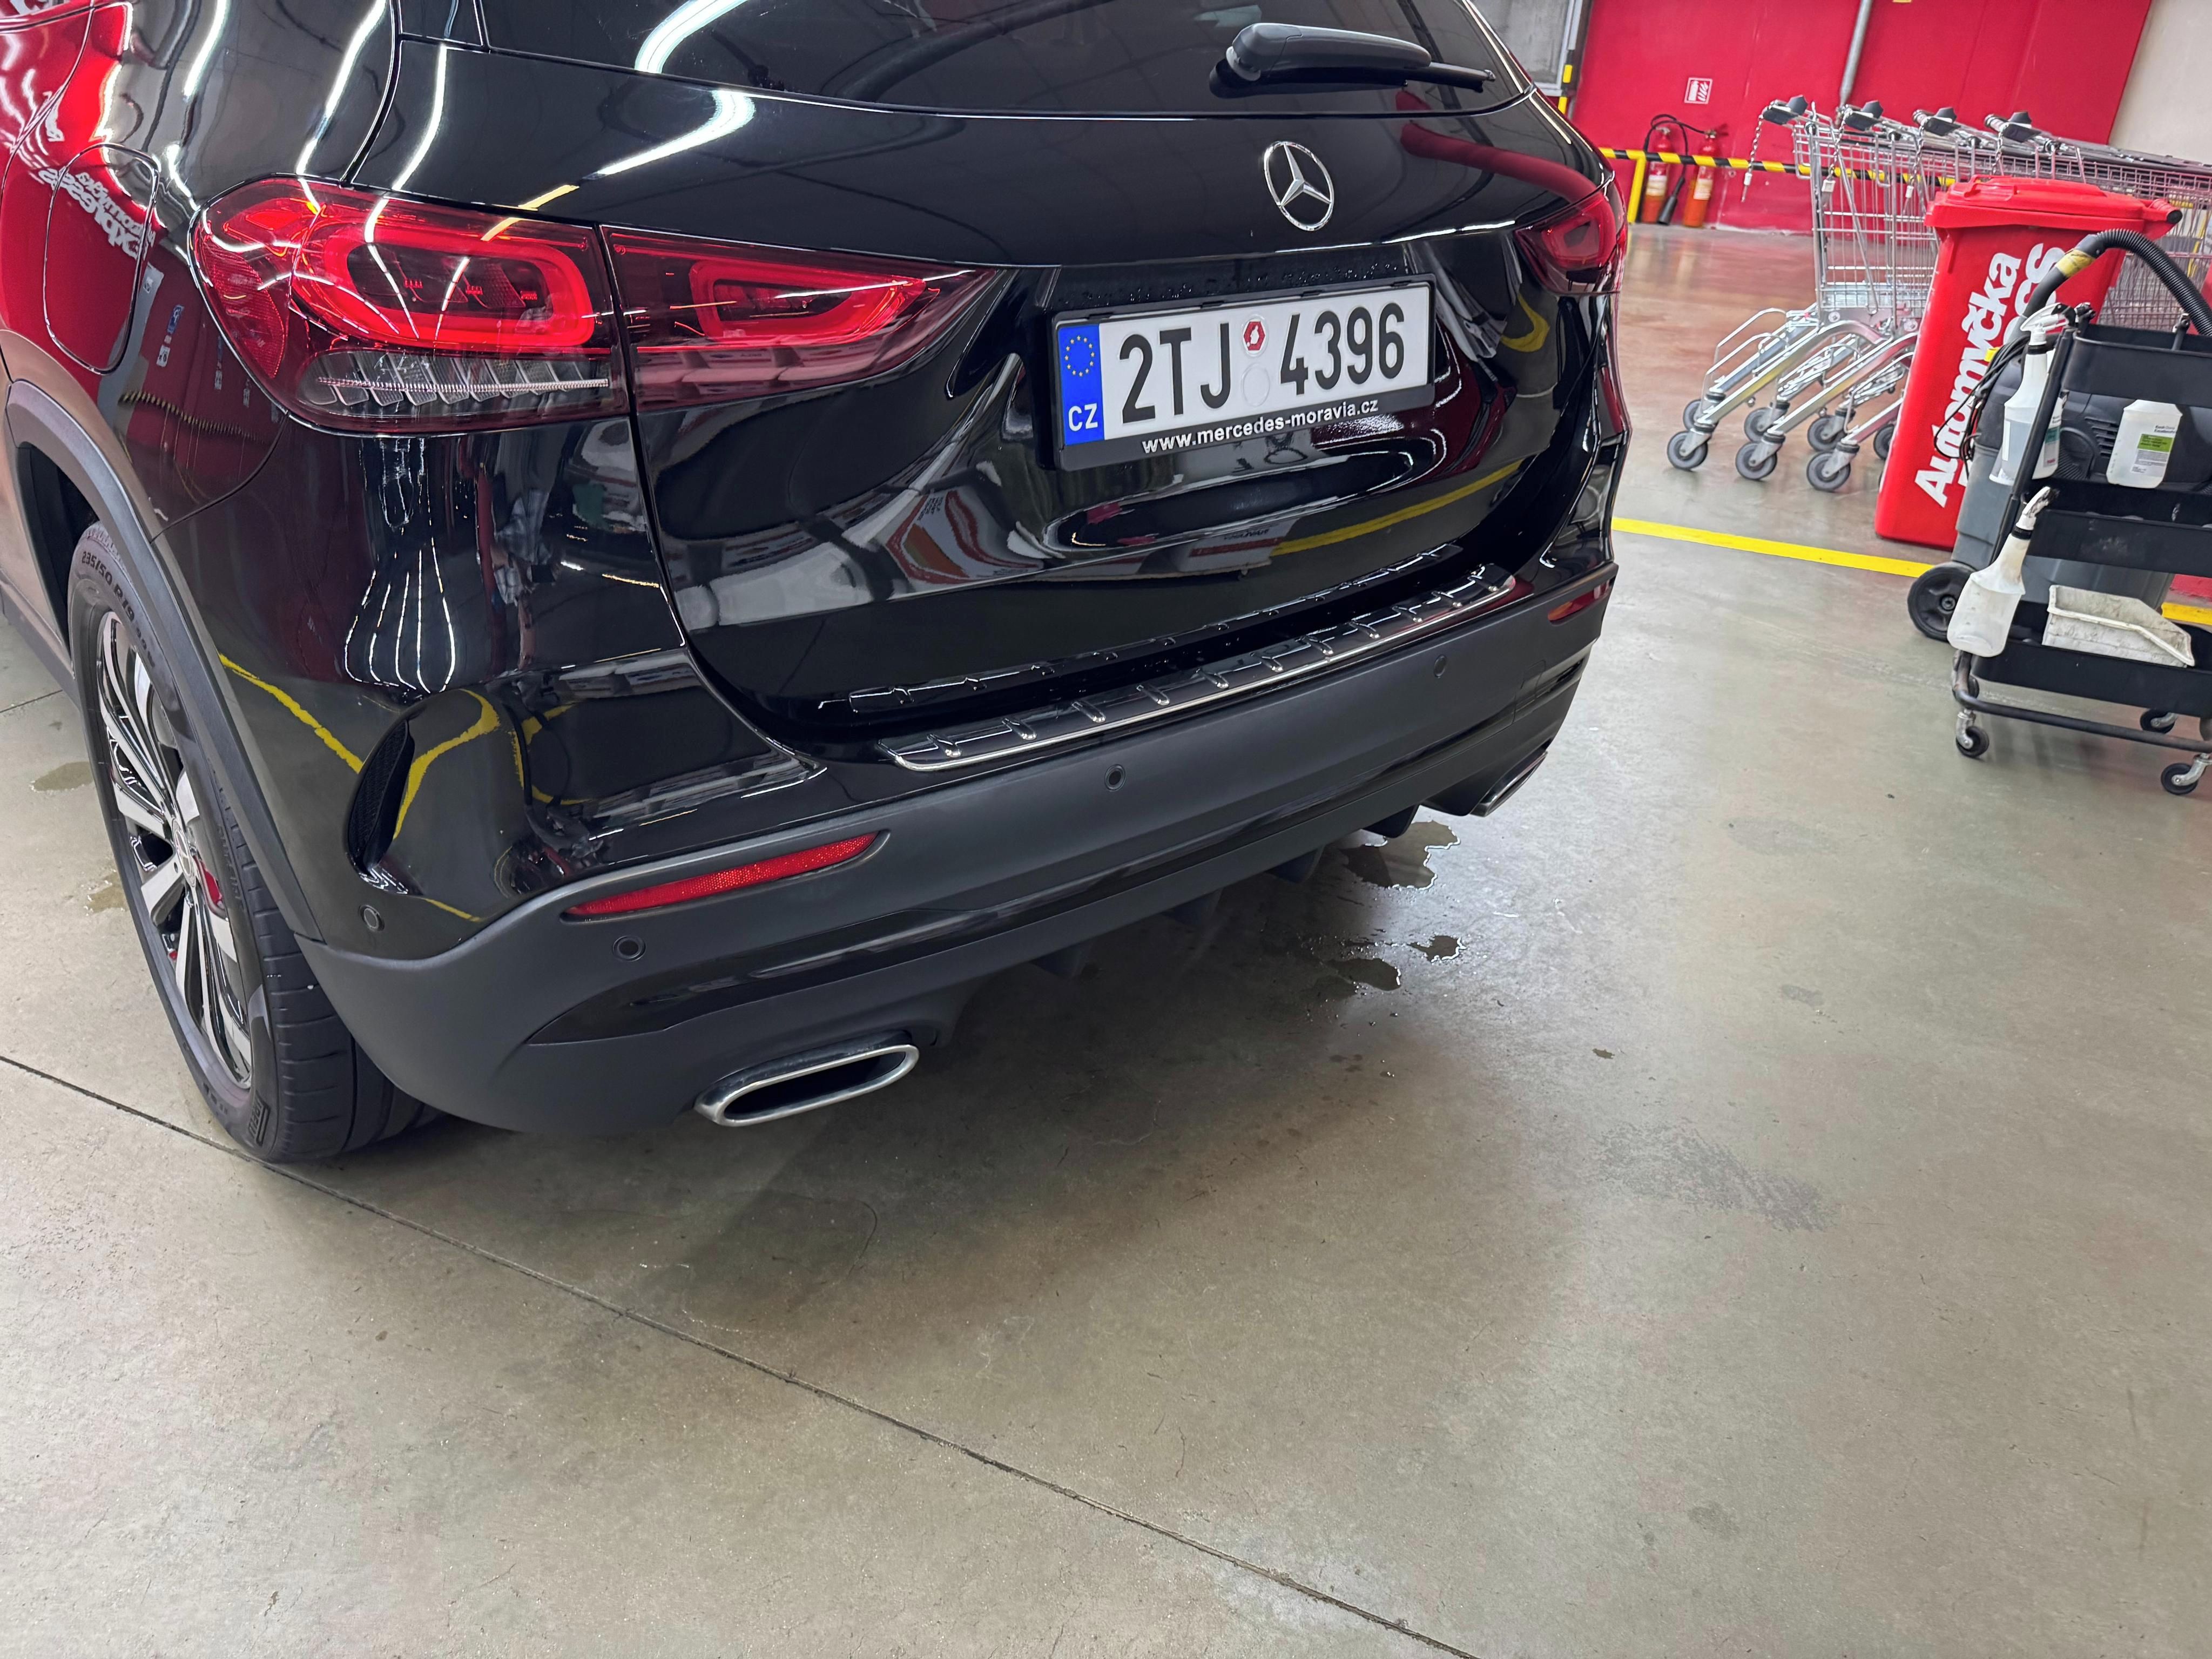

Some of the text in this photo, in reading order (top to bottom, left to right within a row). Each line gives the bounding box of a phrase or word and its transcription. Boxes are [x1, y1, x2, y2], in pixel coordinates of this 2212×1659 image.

[1119, 302, 1405, 424] 2TJ 4396
[1068, 403, 1098, 432] CZ
[1142, 399, 1379, 454] www.mercedes-moravia.cz
[82, 551, 113, 586] 235/50
